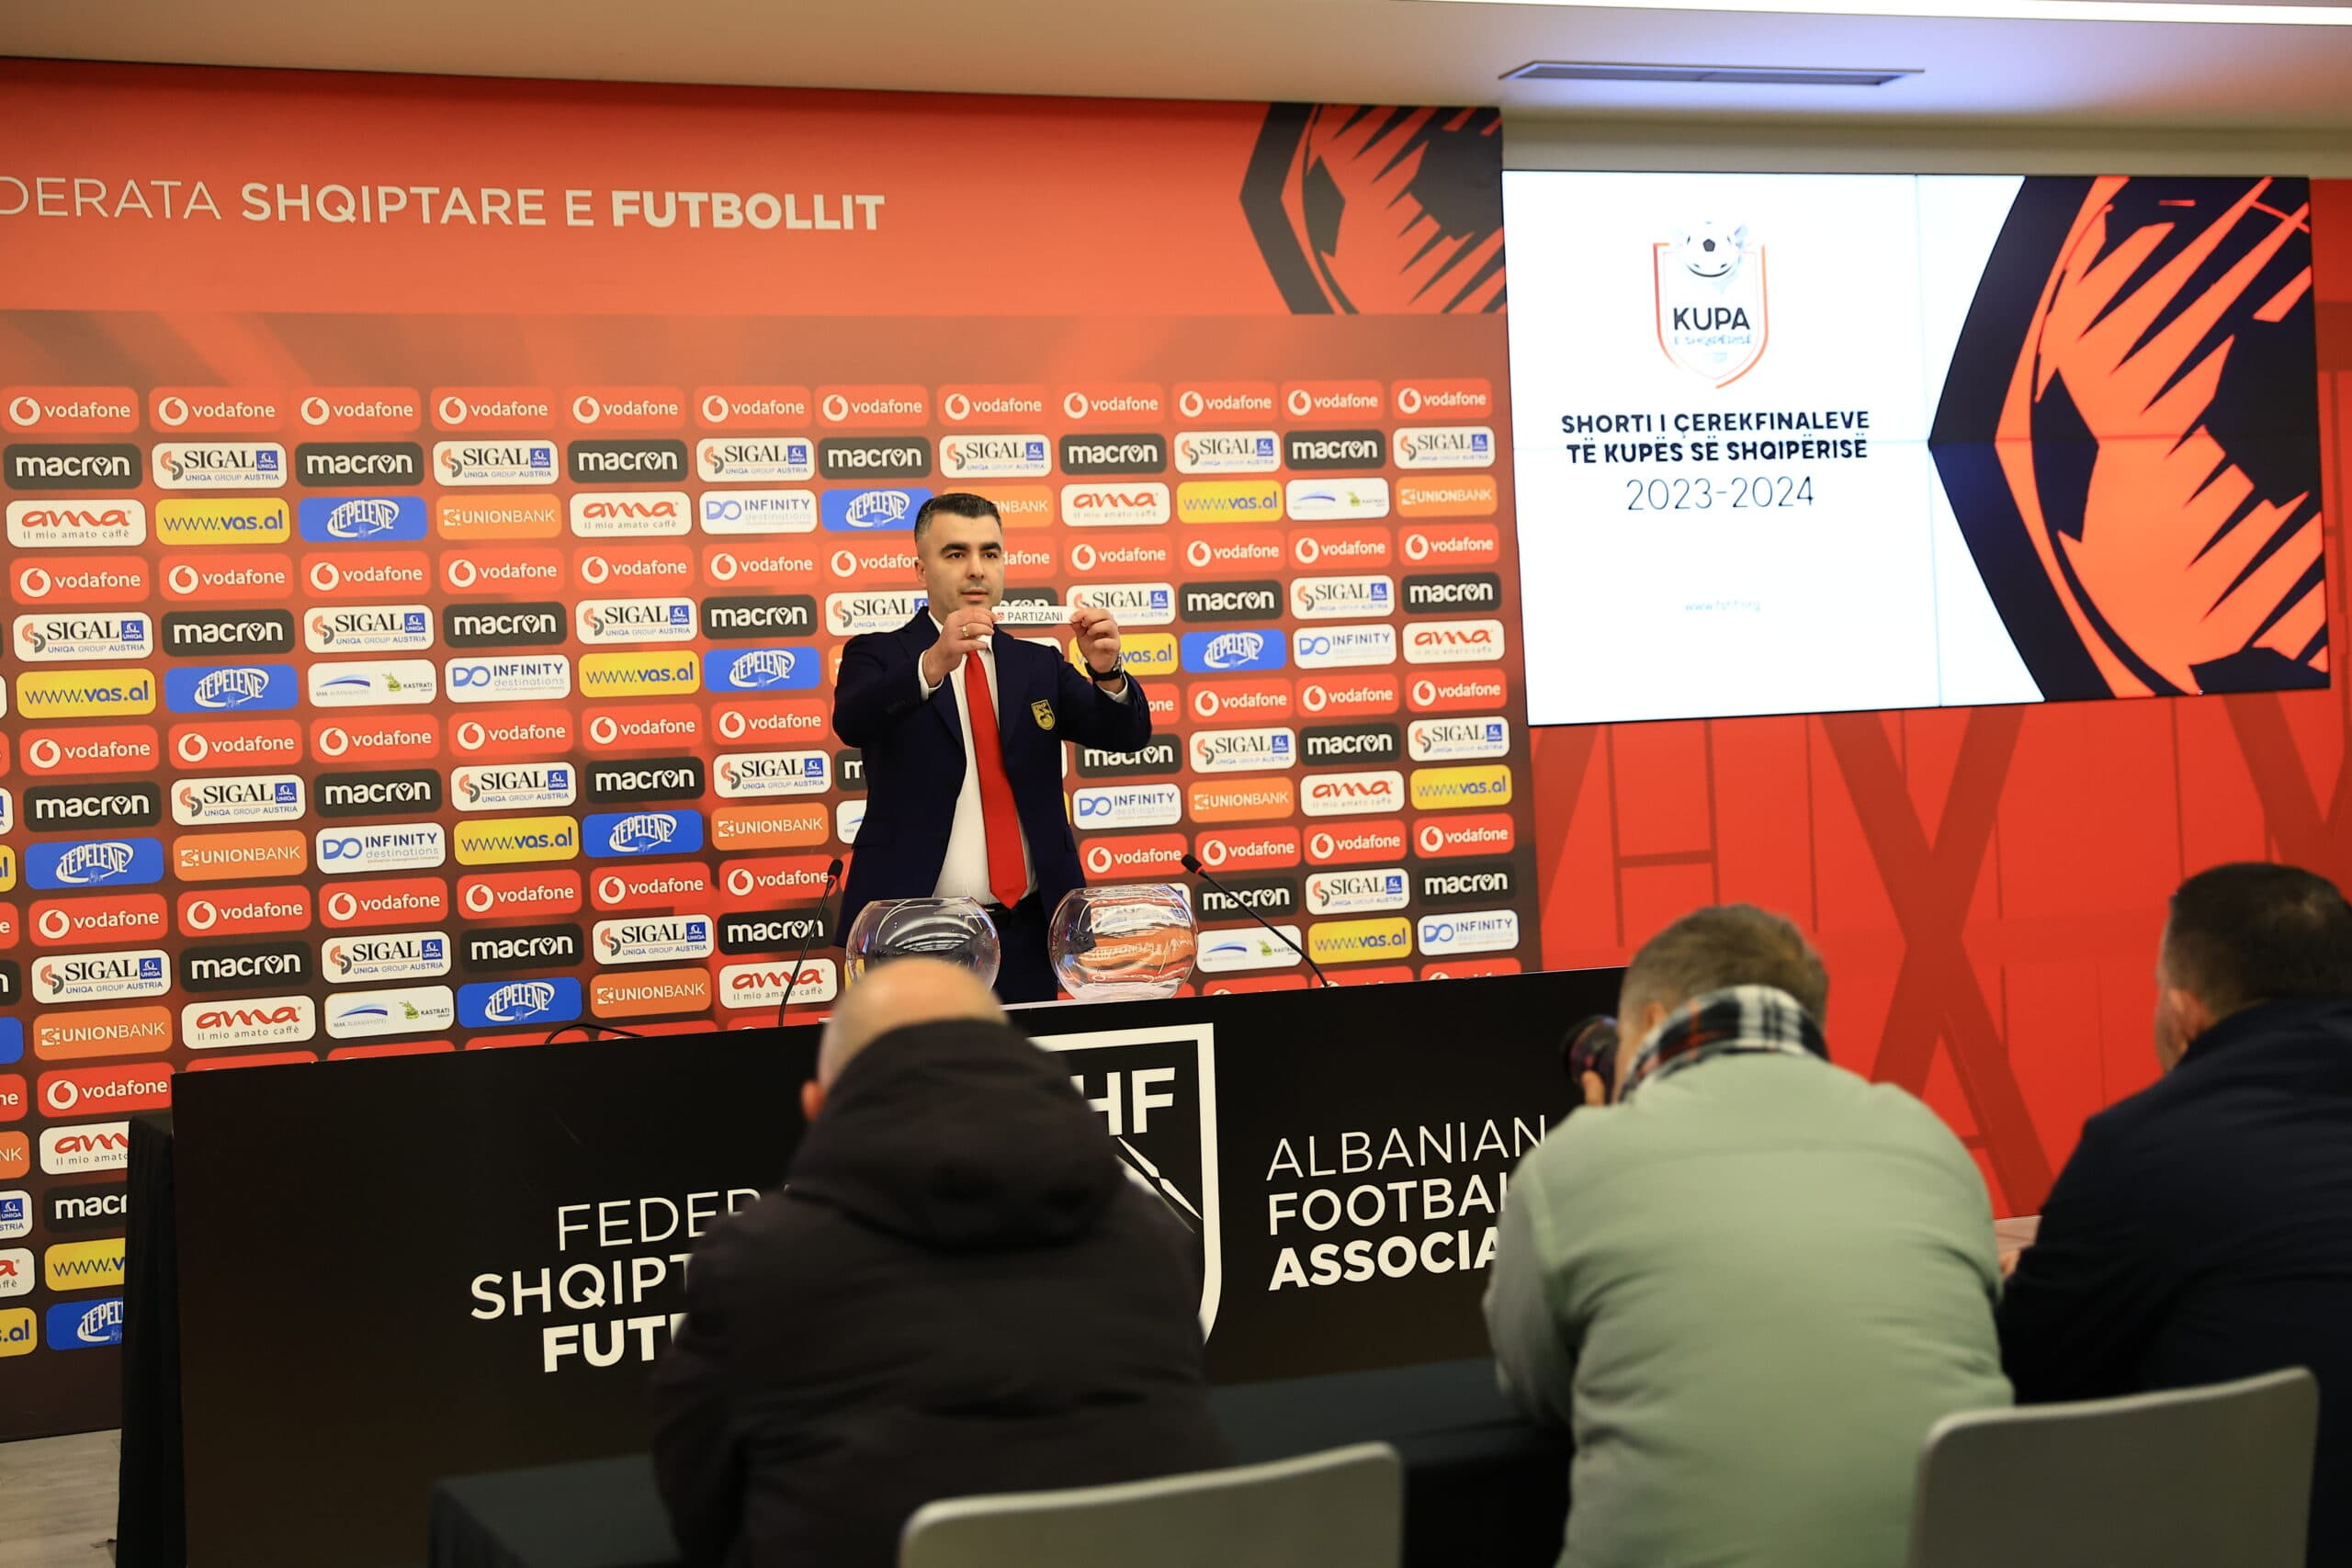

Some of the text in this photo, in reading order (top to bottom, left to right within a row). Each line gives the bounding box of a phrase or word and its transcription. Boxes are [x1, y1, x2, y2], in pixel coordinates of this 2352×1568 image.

[242, 182, 546, 226] SHQIPTARE
[565, 189, 594, 226] E
[612, 190, 886, 231] FUTBOLLIT
[1673, 307, 1750, 331] KUPA
[603, 400, 678, 414] vodafone
[731, 400, 805, 414] vodafone
[851, 399, 922, 412] vodafone
[972, 398, 1041, 412] vodafone
[1091, 397, 1158, 411] vodafone
[1205, 396, 1272, 409] vodafone
[1314, 394, 1377, 407] vodafone
[1423, 392, 1485, 405] vodafone
[44, 402, 130, 417] vodafone
[192, 402, 275, 417] vodafone
[333, 402, 413, 417] vodafone
[470, 401, 548, 415] vodafone
[1562, 411, 1870, 438] SHORTI I ÇEREKFINALEVE
[966, 442, 1024, 458] SIGAL
[1200, 438, 1255, 454] SIGAL
[1292, 441, 1376, 458] macron
[1418, 434, 1470, 450] SIGAL
[1566, 434, 1868, 463] TË KUPËS SË SHQIPËRISË
[185, 450, 254, 468] SIGAL
[463, 448, 528, 466] SIGAL
[577, 452, 677, 470] macron
[724, 446, 786, 462] SIGAL
[827, 448, 922, 467] macron
[1068, 446, 1158, 463] macron
[16, 457, 130, 477] macron
[306, 455, 413, 474] macron
[1183, 491, 1277, 510] www.vas.al
[1417, 490, 1490, 502] UNIONBANK
[1626, 476, 1815, 511] 2023-2024
[744, 498, 809, 511] INFINITY
[164, 508, 283, 530] www.vas.al
[462, 510, 554, 524] UNIONBANK
[1214, 545, 1279, 558] vodafone
[1321, 541, 1385, 555] vodafone
[1430, 537, 1492, 551] vodafone
[1098, 547, 1165, 561] vodafone
[479, 563, 557, 579] vodafone
[612, 560, 687, 575] vodafone
[740, 557, 813, 571] vodafone
[54, 572, 140, 588] vodafone
[201, 569, 284, 584] vodafone
[342, 566, 423, 581] vodafone
[1092, 591, 1148, 608] SIGAL
[1316, 583, 1369, 600] SIGAL
[1410, 584, 1492, 602] macron
[853, 598, 912, 615] SIGAL
[1187, 592, 1273, 611] macron
[335, 613, 402, 632] SIGAL
[605, 605, 668, 624] SIGAL
[710, 607, 808, 626] macron
[1007, 611, 1063, 621] PARTIZANI
[47, 621, 119, 640] SIGAL
[173, 622, 283, 644] macron
[453, 615, 556, 635] macron
[1333, 633, 1389, 646] INFINITY
[493, 662, 562, 677] INFINITY
[586, 660, 694, 683] www.vas.al
[25, 679, 148, 704] www.vas.al
[1329, 688, 1392, 702] vodafone
[1438, 682, 1499, 697] vodafone
[1221, 693, 1286, 707] vodafone
[620, 718, 695, 734] vodafone
[748, 714, 821, 729] vodafone
[351, 730, 431, 746] vodafone
[488, 725, 566, 740] vodafone
[1432, 725, 1485, 742] SIGAL
[64, 741, 150, 758] vodafone
[211, 736, 294, 751] vodafone
[1216, 736, 1270, 753] SIGAL
[1307, 735, 1392, 754] macron
[741, 759, 803, 778] SIGAL
[481, 771, 546, 791] SIGAL
[594, 769, 695, 791] macron
[1418, 774, 1506, 796] www.vas.al
[204, 784, 273, 804] SIGAL
[324, 782, 430, 805] macron
[1114, 792, 1174, 807] INFINITY
[1210, 792, 1287, 807] UNIONBANK
[36, 795, 149, 818] macron
[736, 818, 822, 833] UNIONBANK
[366, 832, 436, 848] INFINITY
[461, 826, 572, 852] www.vas.al
[1336, 835, 1399, 850] vodafone
[1445, 828, 1507, 842] vodafone
[201, 846, 300, 863] UNIONBANK
[366, 846, 438, 859] destinations
[1114, 848, 1181, 863] vodafone
[1228, 841, 1294, 857] vodafone
[628, 877, 704, 894] vodafone
[756, 870, 829, 886] vodafone
[1330, 876, 1384, 895] SIGAL
[1425, 873, 1507, 894] macron
[360, 894, 440, 910] vodafone
[496, 886, 574, 902] vodafone
[220, 902, 302, 919] vodafone
[74, 910, 158, 929] vodafone
[1456, 918, 1511, 932] INFINITY
[622, 923, 684, 943] SIGAL
[727, 919, 824, 942] macron
[1315, 927, 1406, 951] www.vas.al
[353, 941, 420, 962] SIGAL
[470, 936, 573, 960] macron
[65, 959, 137, 981] SIGAL
[191, 953, 300, 979] macron
[353, 966, 379, 975] UNIQA
[410, 962, 443, 970] AUSTRIA
[66, 982, 162, 994] UNIQA GROUP AUSTRIA
[616, 983, 705, 1000] UNIONBANK
[63, 1022, 164, 1042] UNIONBANK
[209, 1031, 229, 1039] mio
[234, 1029, 268, 1038] amato
[82, 1079, 166, 1099] vodafone
[1266, 1114, 1545, 1181] ALBANIAN
